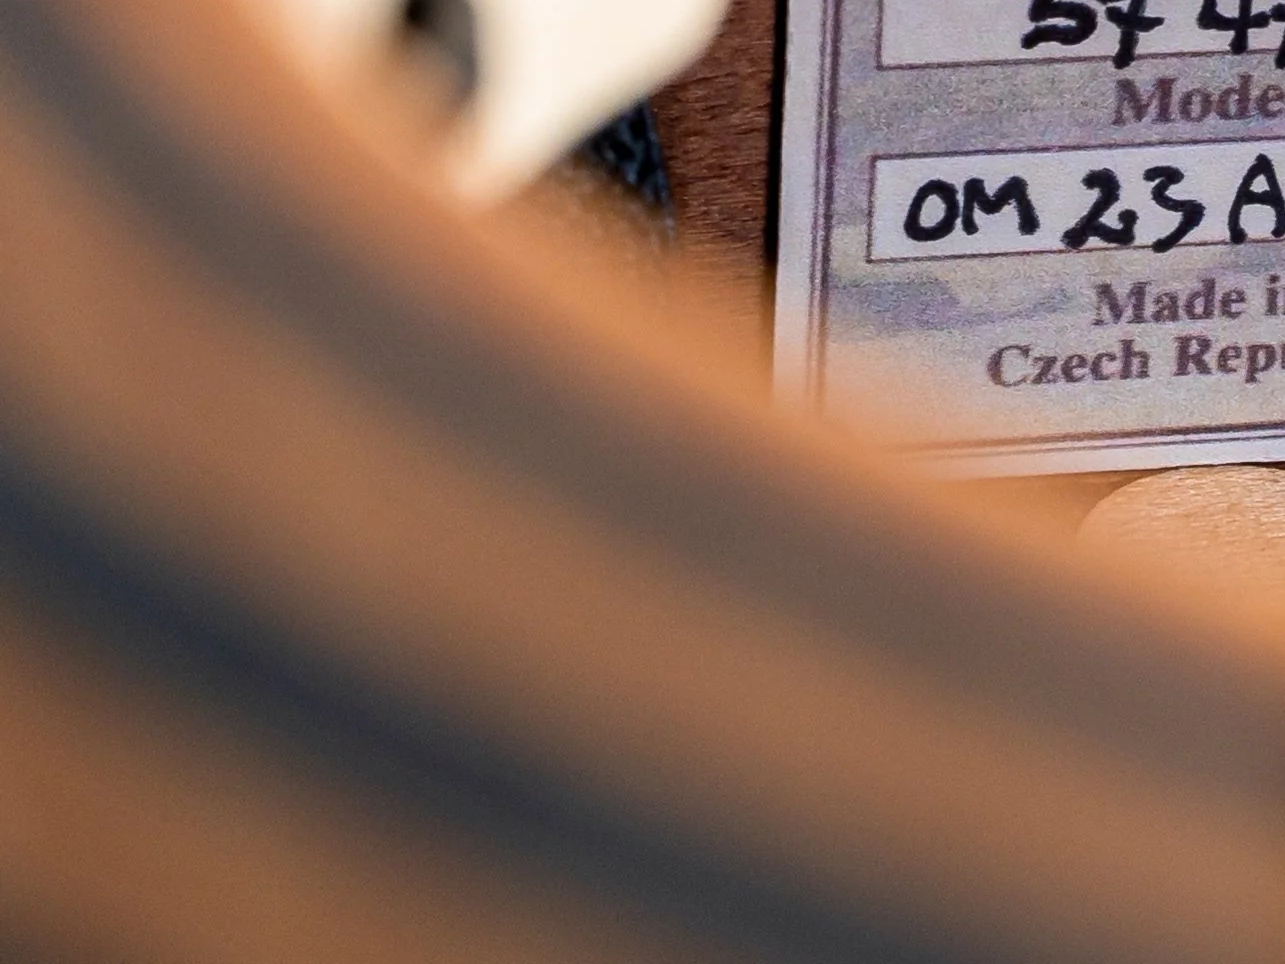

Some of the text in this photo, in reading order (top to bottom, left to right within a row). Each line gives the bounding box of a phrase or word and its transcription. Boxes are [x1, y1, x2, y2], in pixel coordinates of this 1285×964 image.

[903, 174, 1040, 243] OM
[1061, 164, 1205, 253] 23
[1093, 280, 1246, 327] Made
[986, 343, 1152, 388] Czech
